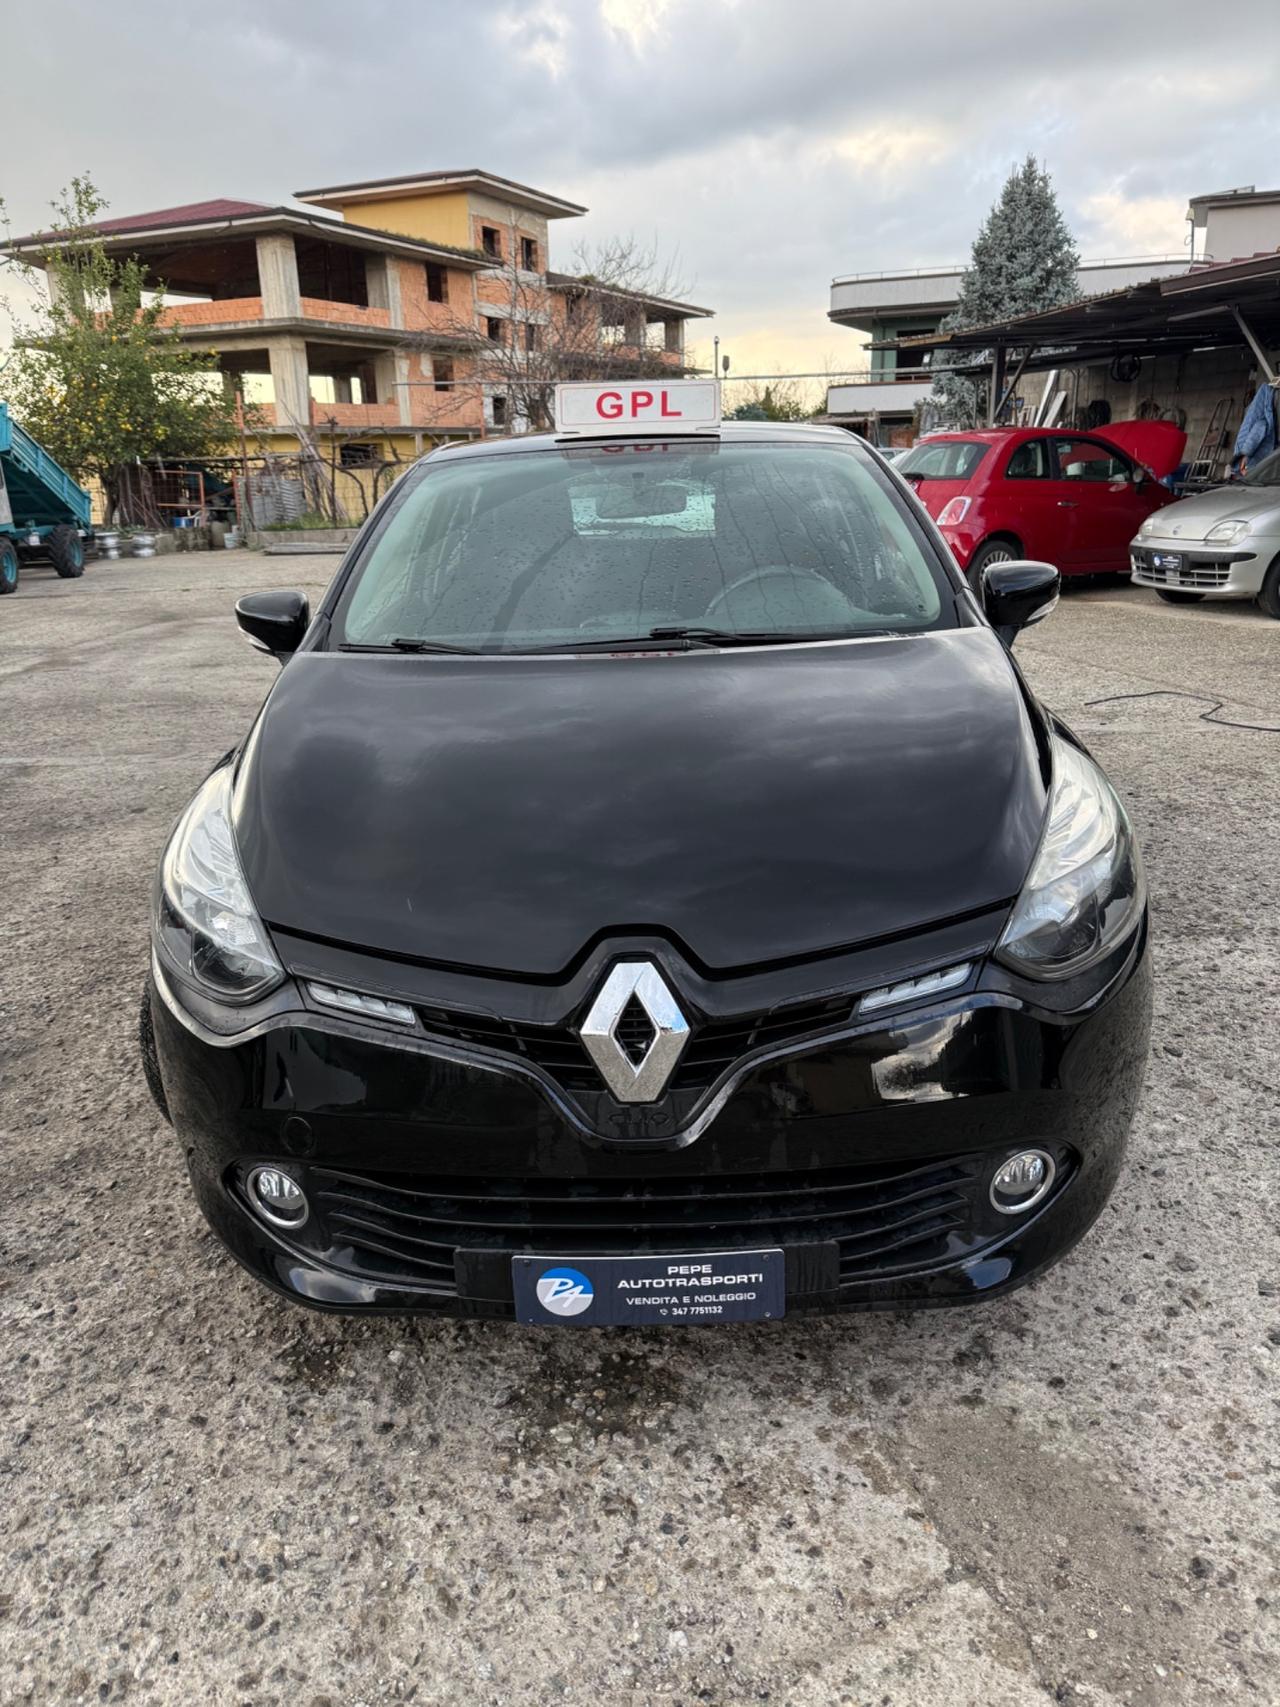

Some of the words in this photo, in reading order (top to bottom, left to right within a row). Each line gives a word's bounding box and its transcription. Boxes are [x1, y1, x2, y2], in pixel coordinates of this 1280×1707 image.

[596, 391, 682, 419] GPL
[667, 1264, 712, 1275] PEPE
[617, 1273, 763, 1288] AUTOTRASPORTI
[626, 1296, 679, 1305] VENDITA
[694, 1292, 756, 1303] NOLEGGIO
[671, 1307, 688, 1315] 347
[690, 1305, 723, 1315] 7751132
